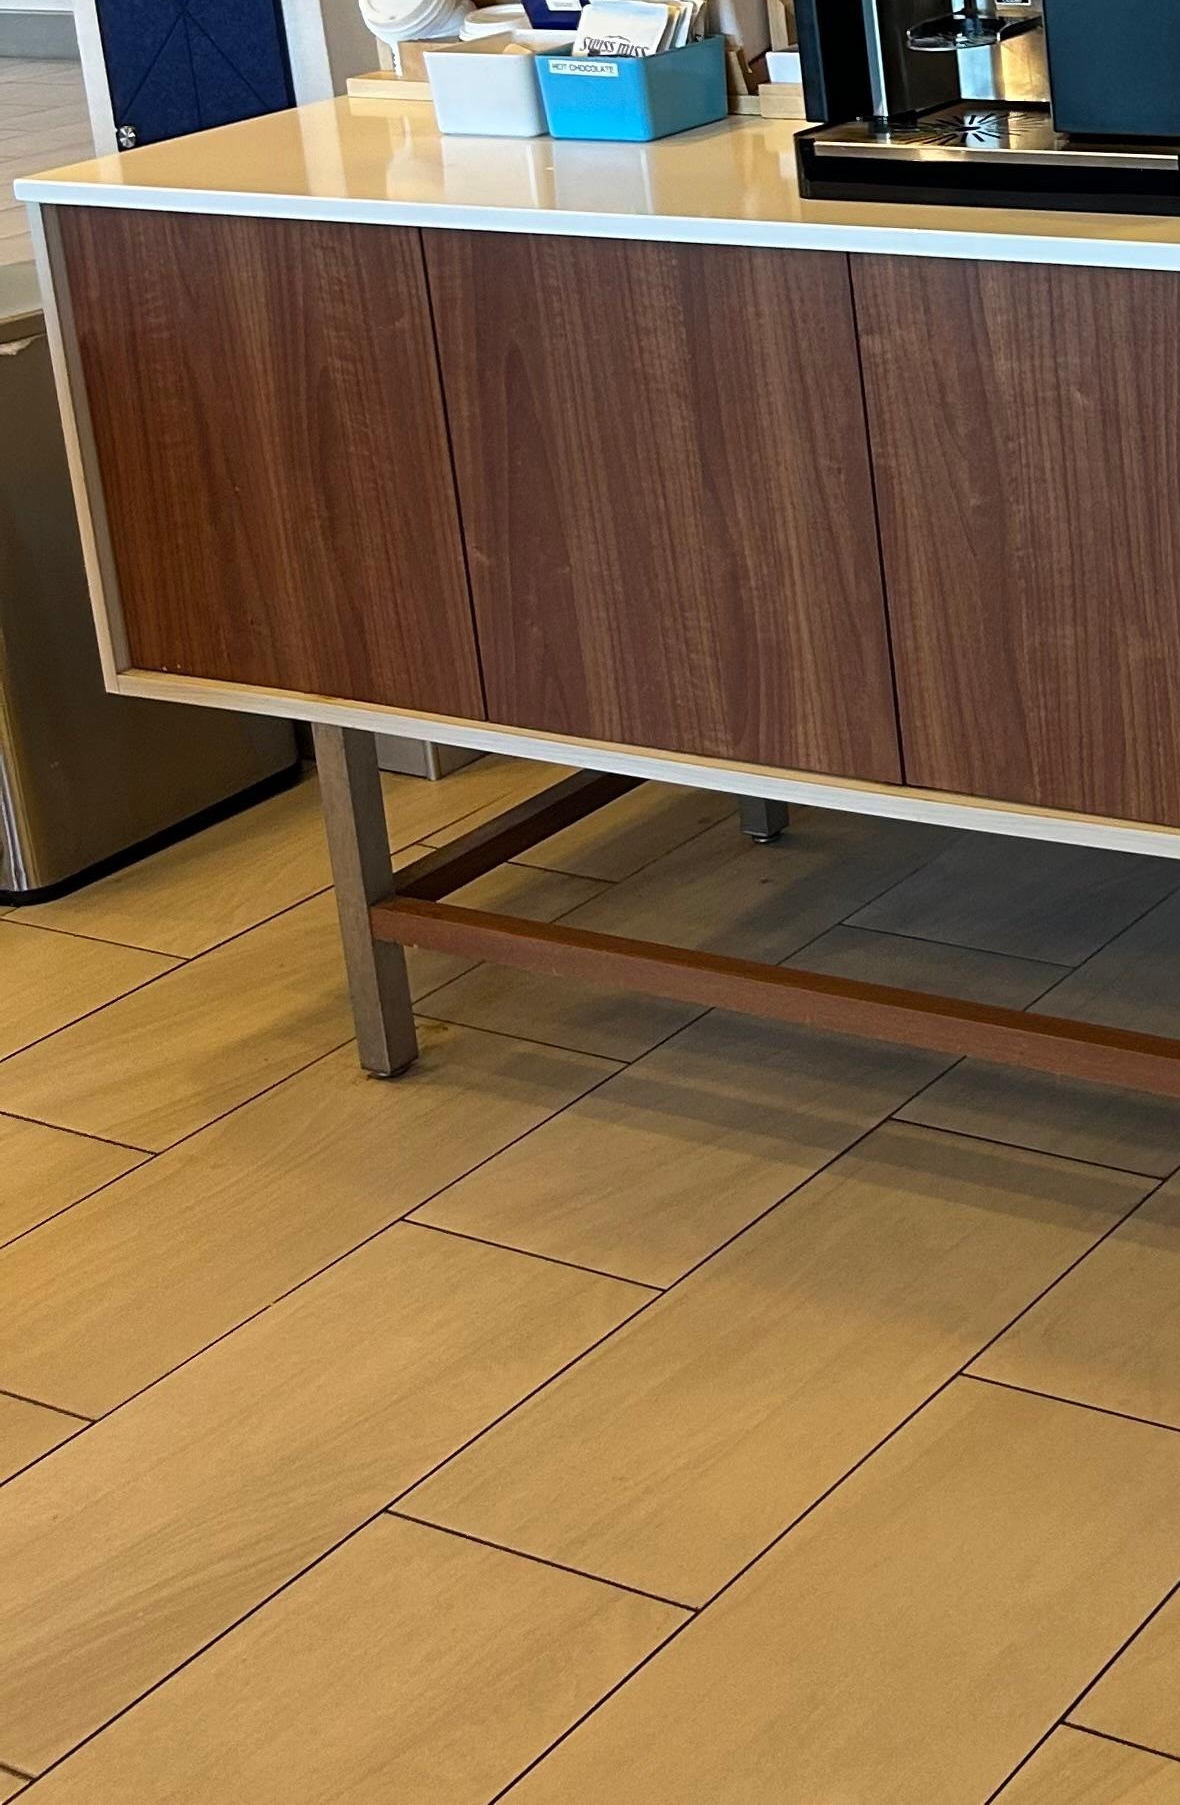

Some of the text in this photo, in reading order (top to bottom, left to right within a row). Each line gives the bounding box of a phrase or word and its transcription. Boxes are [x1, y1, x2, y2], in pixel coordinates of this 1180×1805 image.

[579, 36, 616, 53] SWISS
[551, 62, 615, 74] HOT CHOCOLATE
